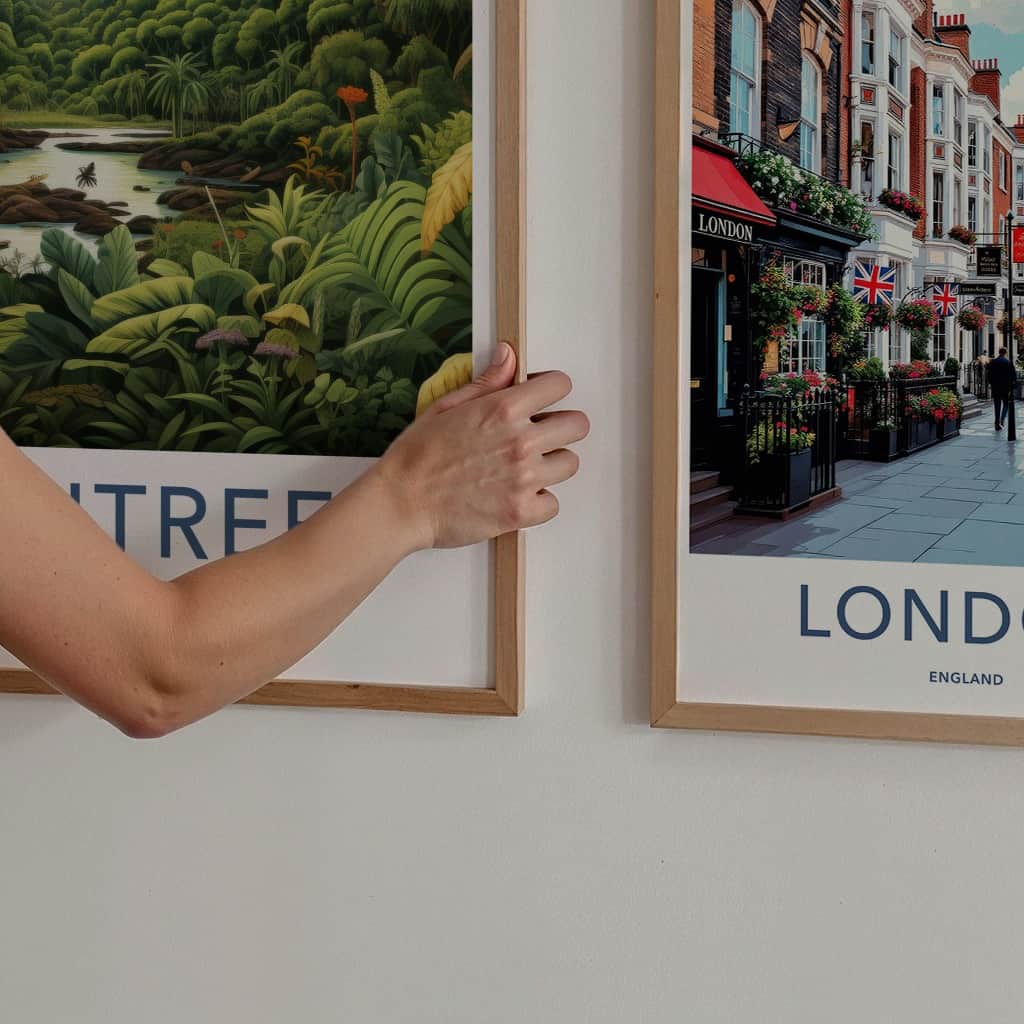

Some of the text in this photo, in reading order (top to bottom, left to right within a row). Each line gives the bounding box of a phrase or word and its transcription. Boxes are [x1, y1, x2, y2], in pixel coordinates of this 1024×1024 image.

[698, 213, 753, 242] LONDON
[800, 584, 1024, 644] LOND
[929, 670, 1004, 686] ENGLAND
